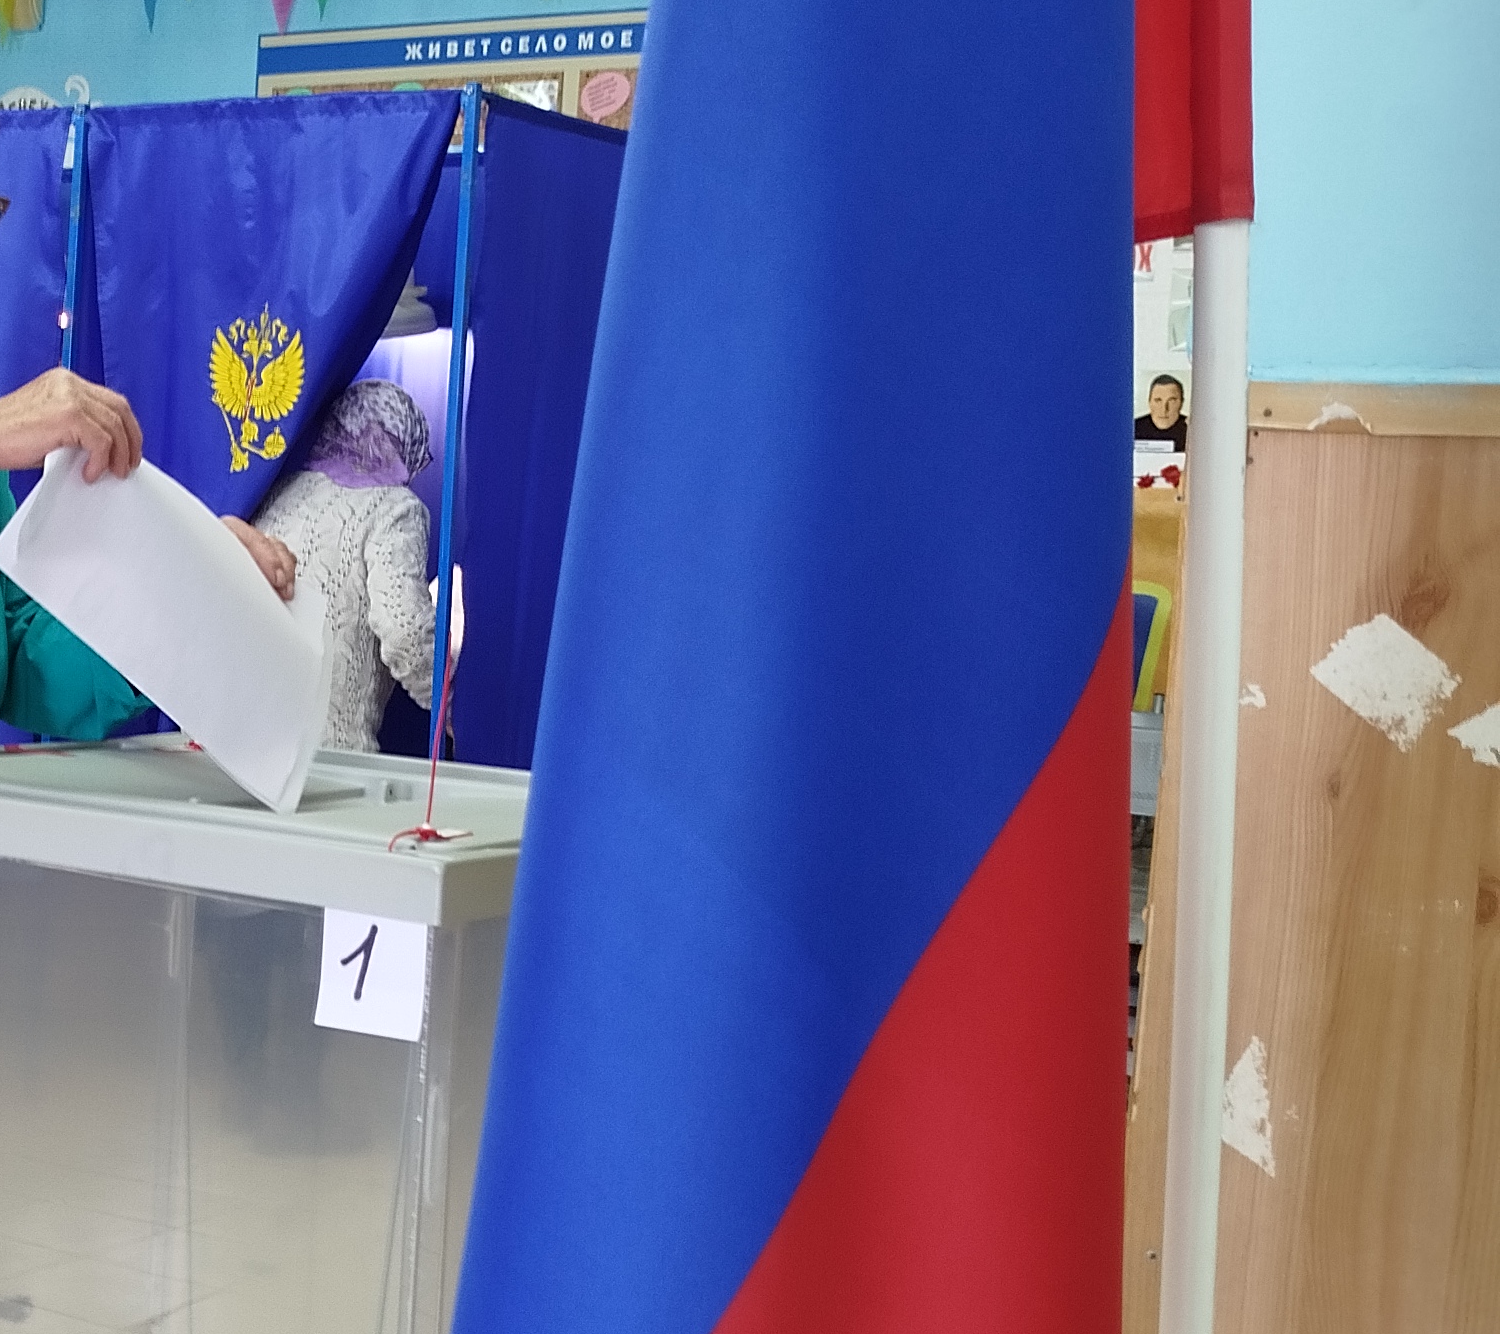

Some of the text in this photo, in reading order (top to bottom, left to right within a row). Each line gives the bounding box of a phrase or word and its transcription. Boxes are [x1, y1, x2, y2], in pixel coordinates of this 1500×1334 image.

[404, 29, 633, 61] ЖИВЕТ СЕЛО МОЕ
[340, 924, 379, 1001] 1
